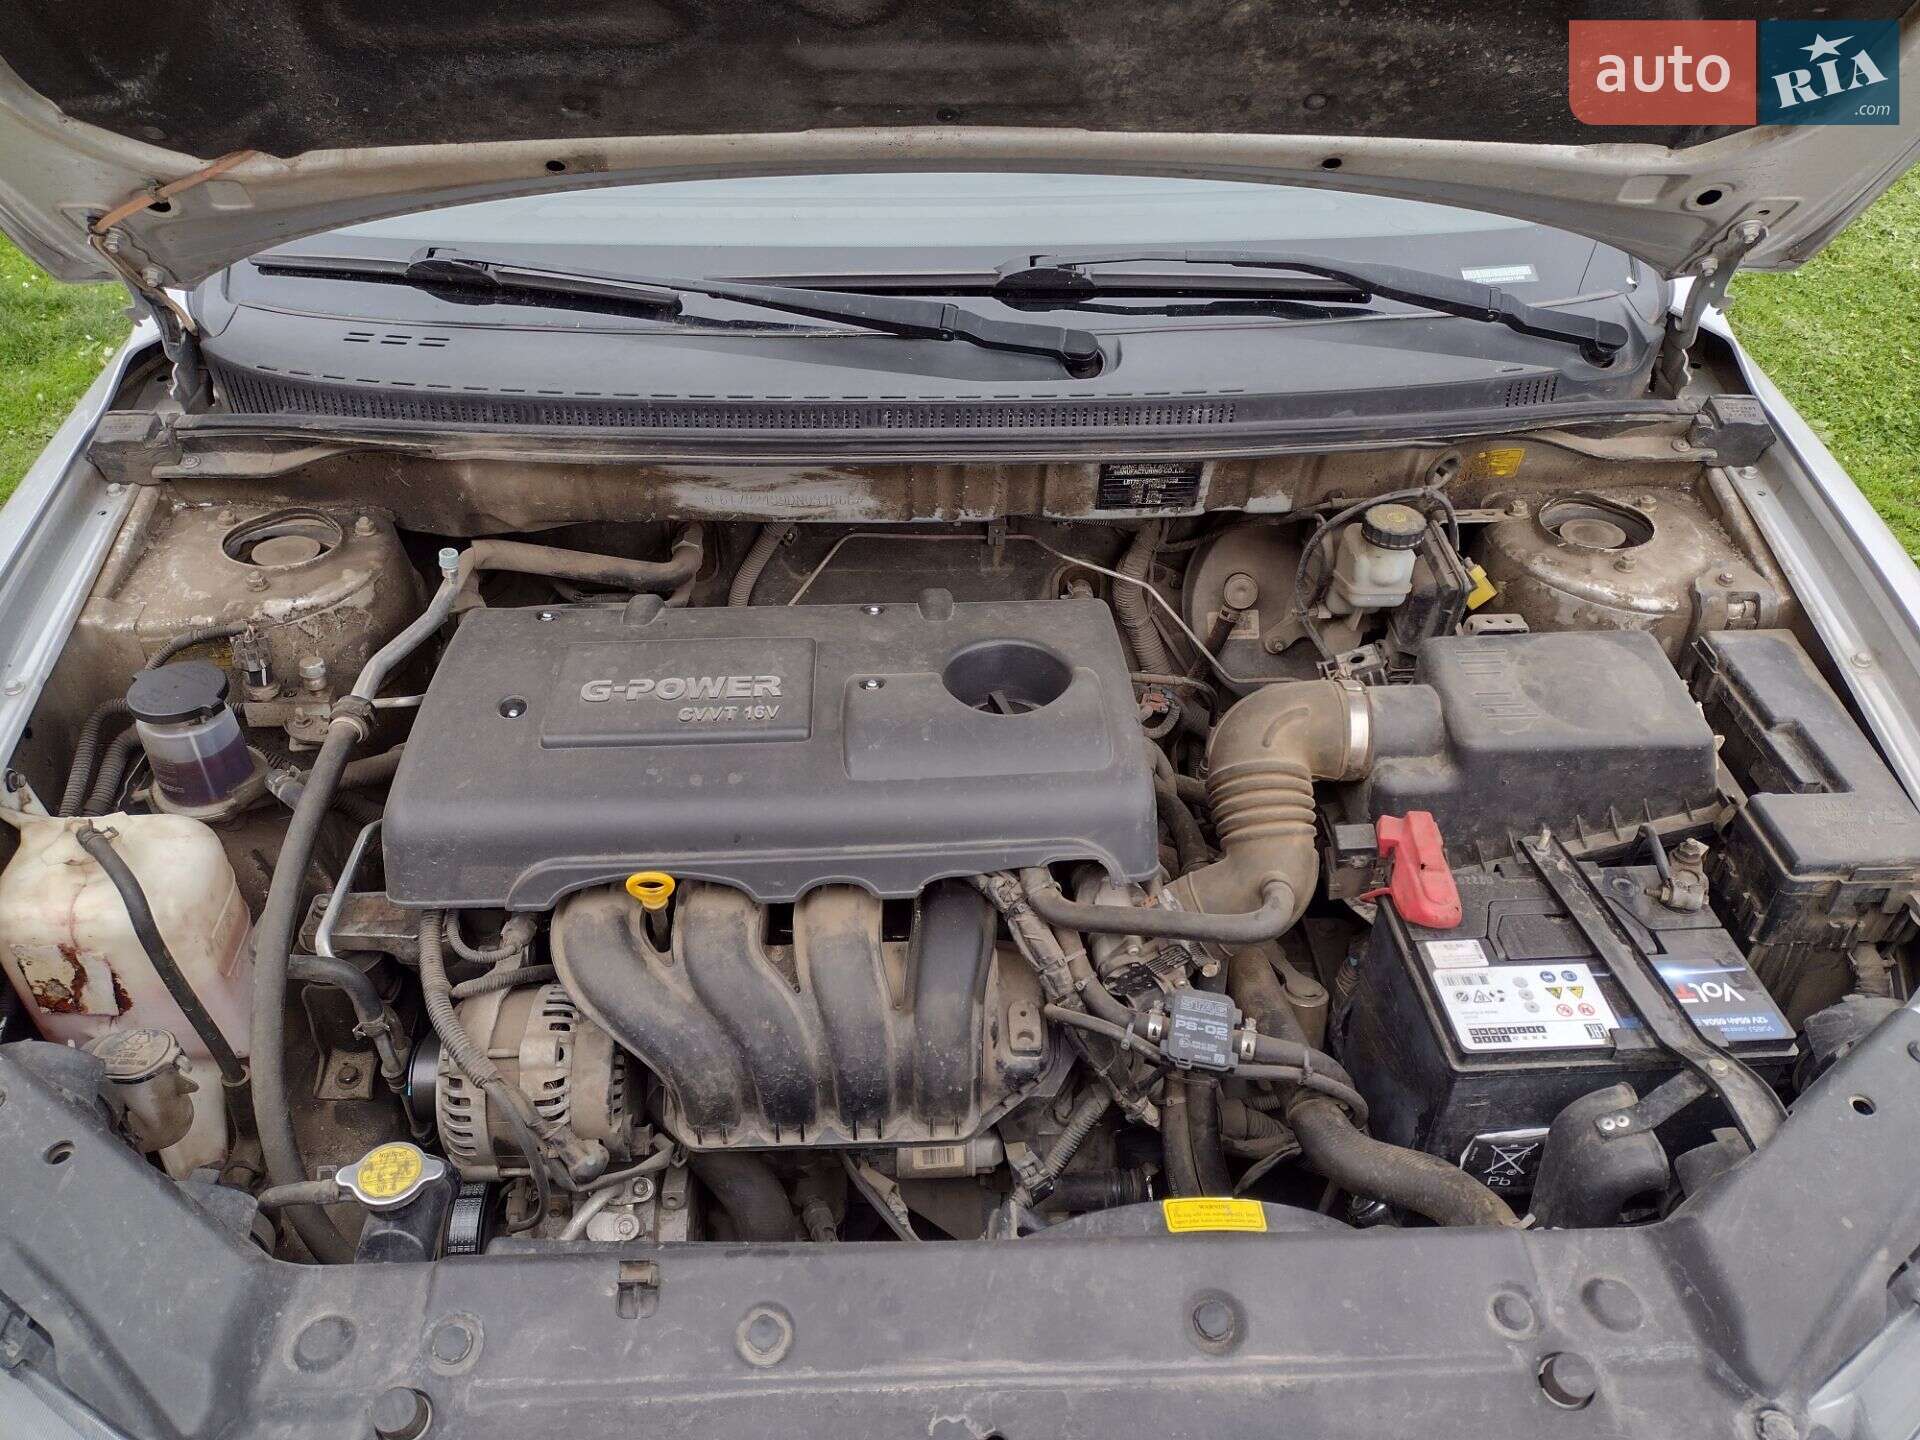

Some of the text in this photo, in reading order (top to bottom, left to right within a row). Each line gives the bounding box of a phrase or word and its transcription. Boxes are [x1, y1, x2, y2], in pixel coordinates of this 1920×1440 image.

[579, 675, 783, 702] G-POWER
[744, 704, 780, 721] 16V
[1175, 1019, 1228, 1036] PS-02
[1487, 1176, 1511, 1186] Pb
